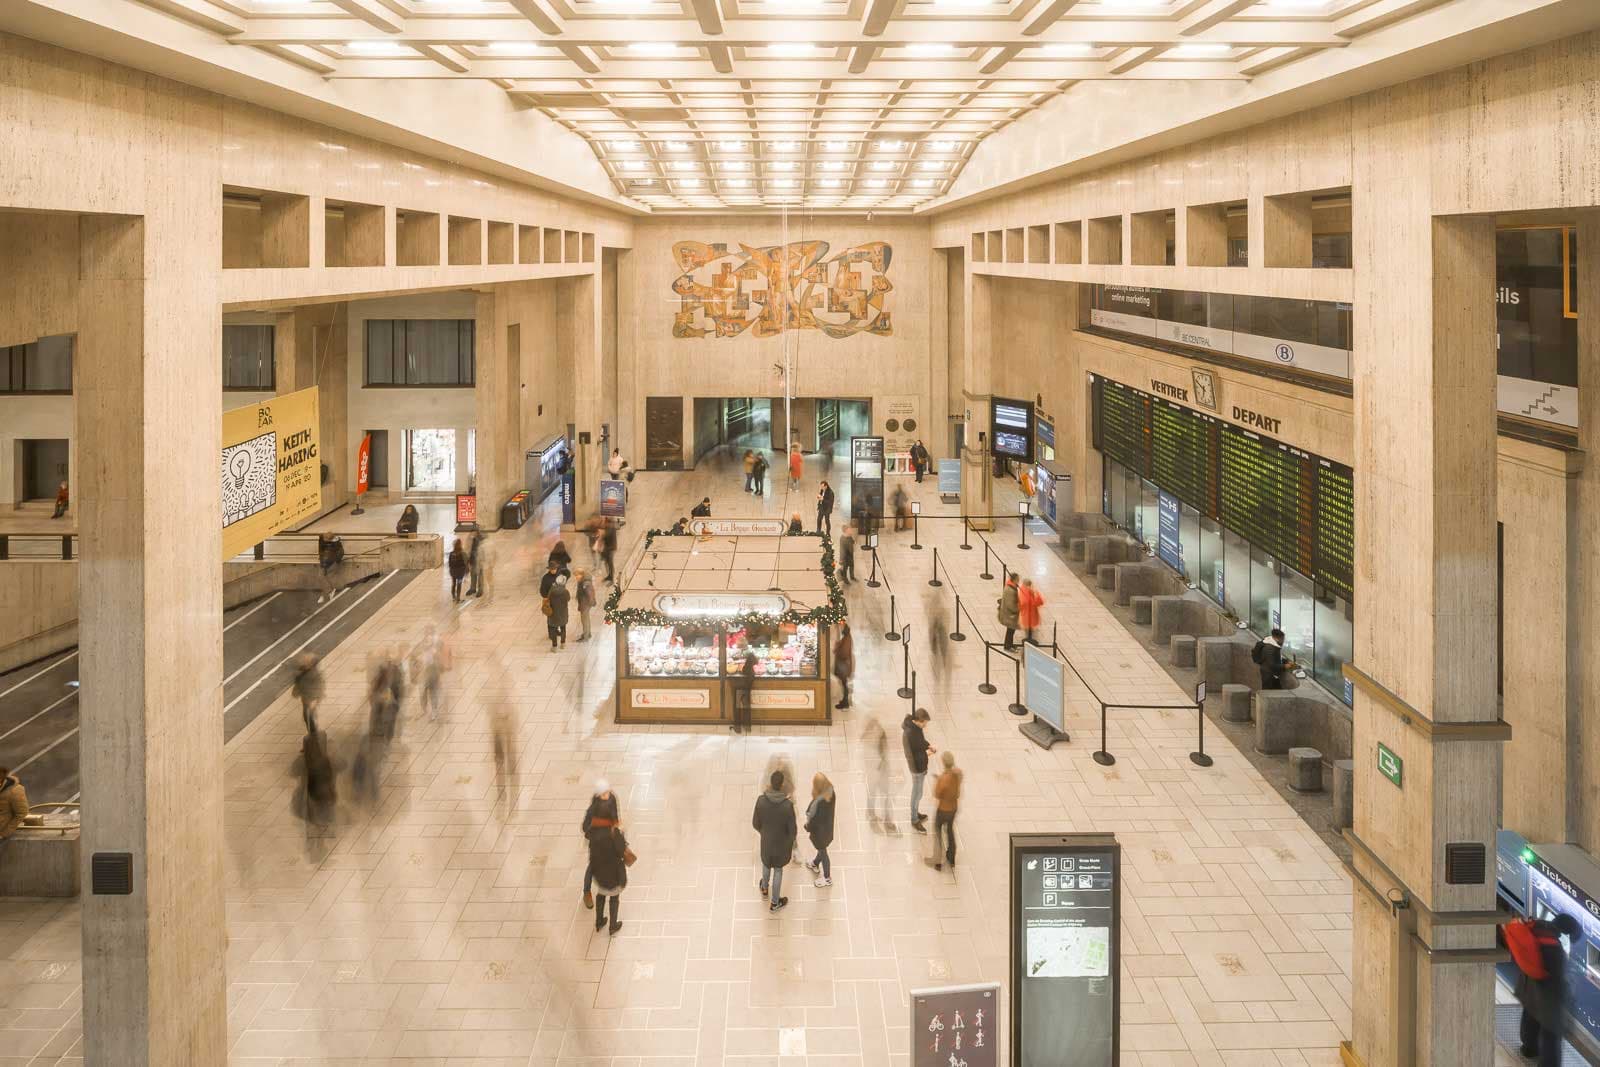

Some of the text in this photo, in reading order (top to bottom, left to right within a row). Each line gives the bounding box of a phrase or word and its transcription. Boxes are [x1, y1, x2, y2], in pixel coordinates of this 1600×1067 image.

[1111, 293, 1151, 307] online marketing
[1151, 379, 1189, 402] VERTREK
[1232, 406, 1281, 434] DEPART
[283, 428, 312, 452] KEITH
[278, 444, 317, 473] HARING
[1540, 860, 1578, 898] Tickets
